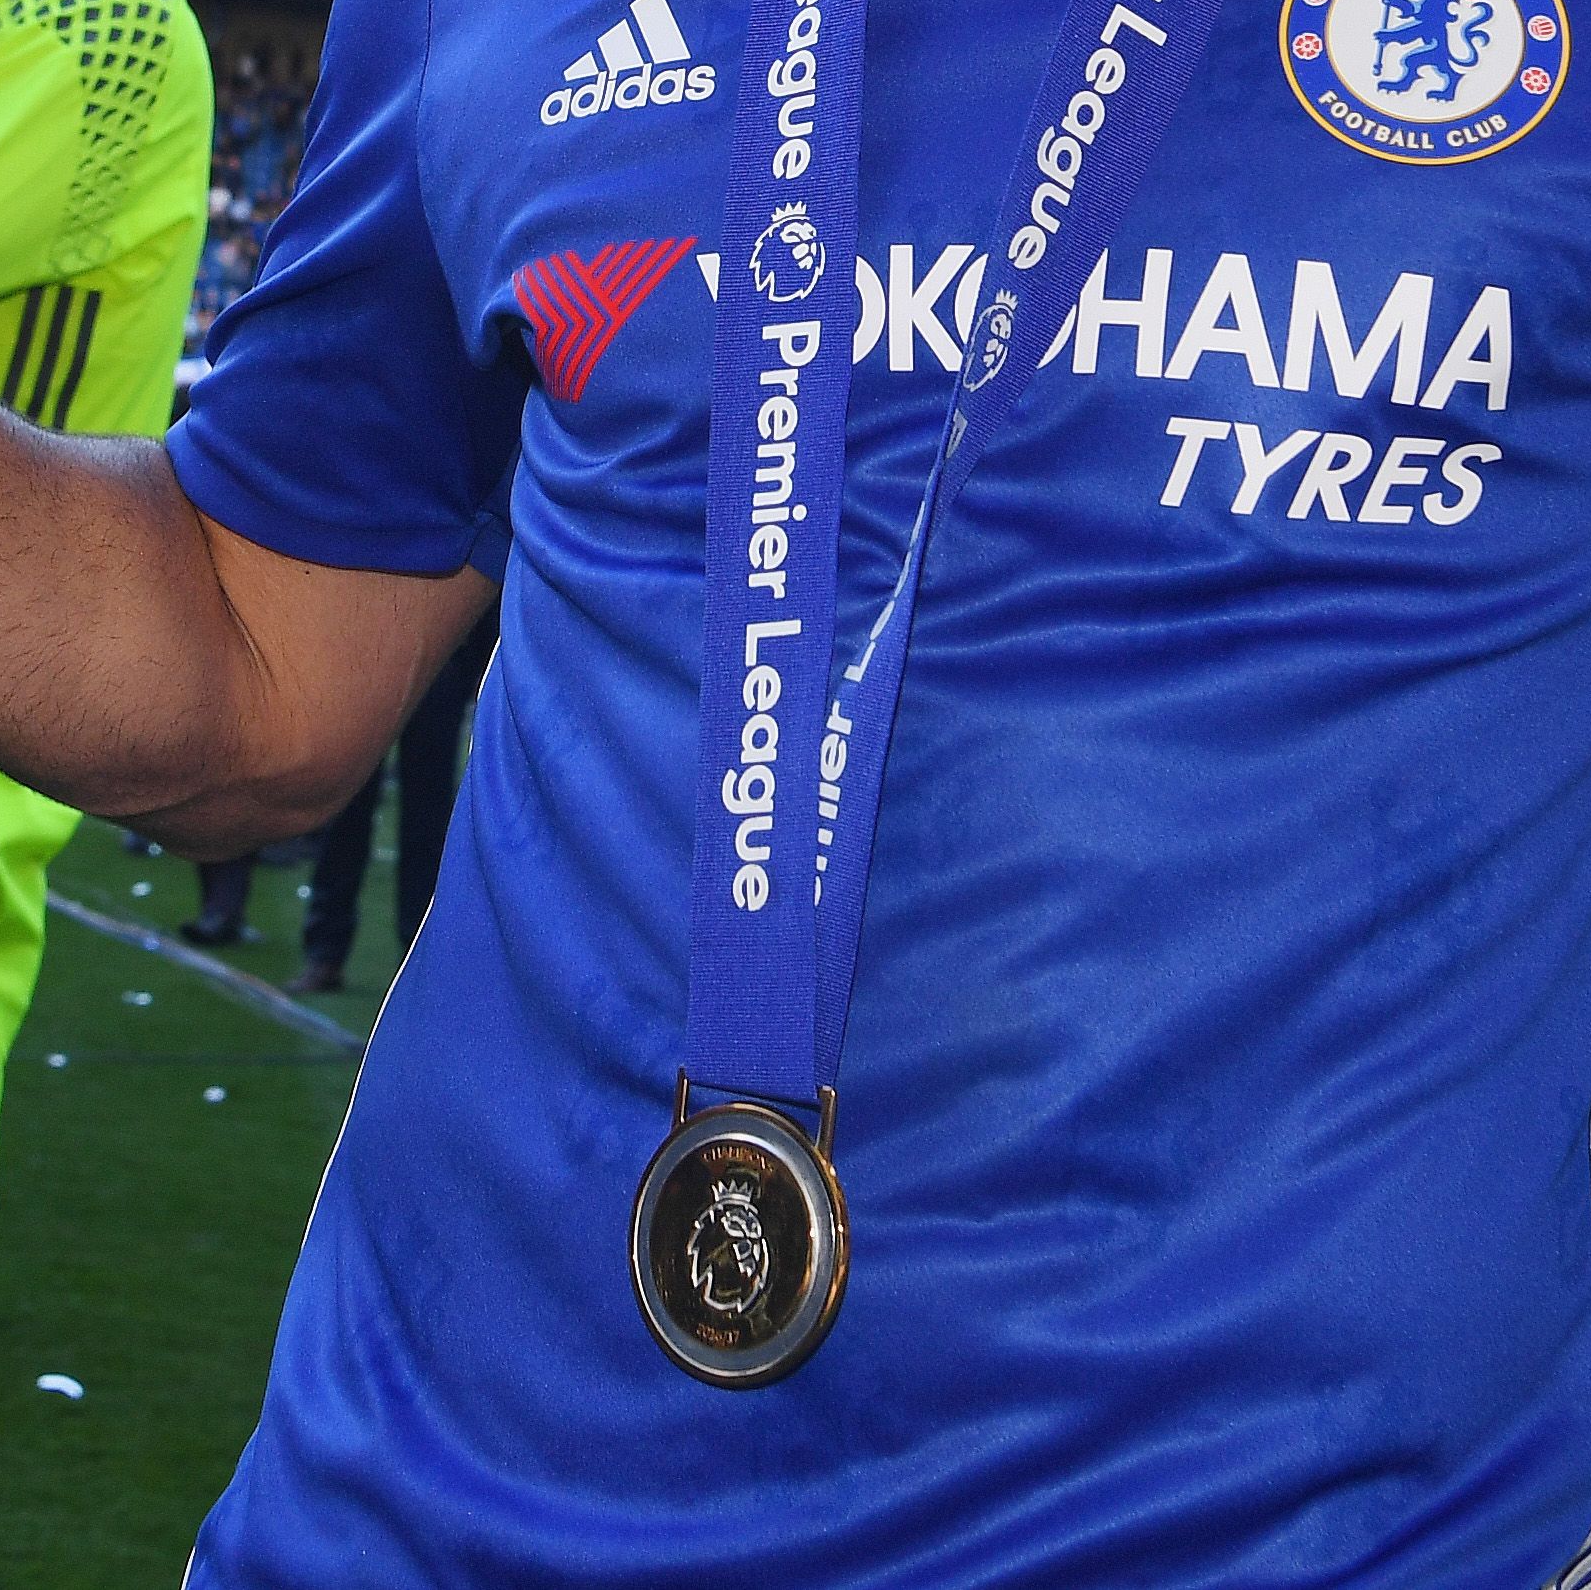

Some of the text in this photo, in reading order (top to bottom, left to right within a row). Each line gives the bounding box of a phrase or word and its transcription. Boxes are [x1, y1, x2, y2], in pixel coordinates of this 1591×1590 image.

[540, 63, 716, 126] adidas
[1009, 2, 1166, 270] League
[1318, 90, 1508, 150] FOOTBALL CLUB
[1160, 417, 1504, 526] TYRES
[722, 321, 821, 911] Premier League
